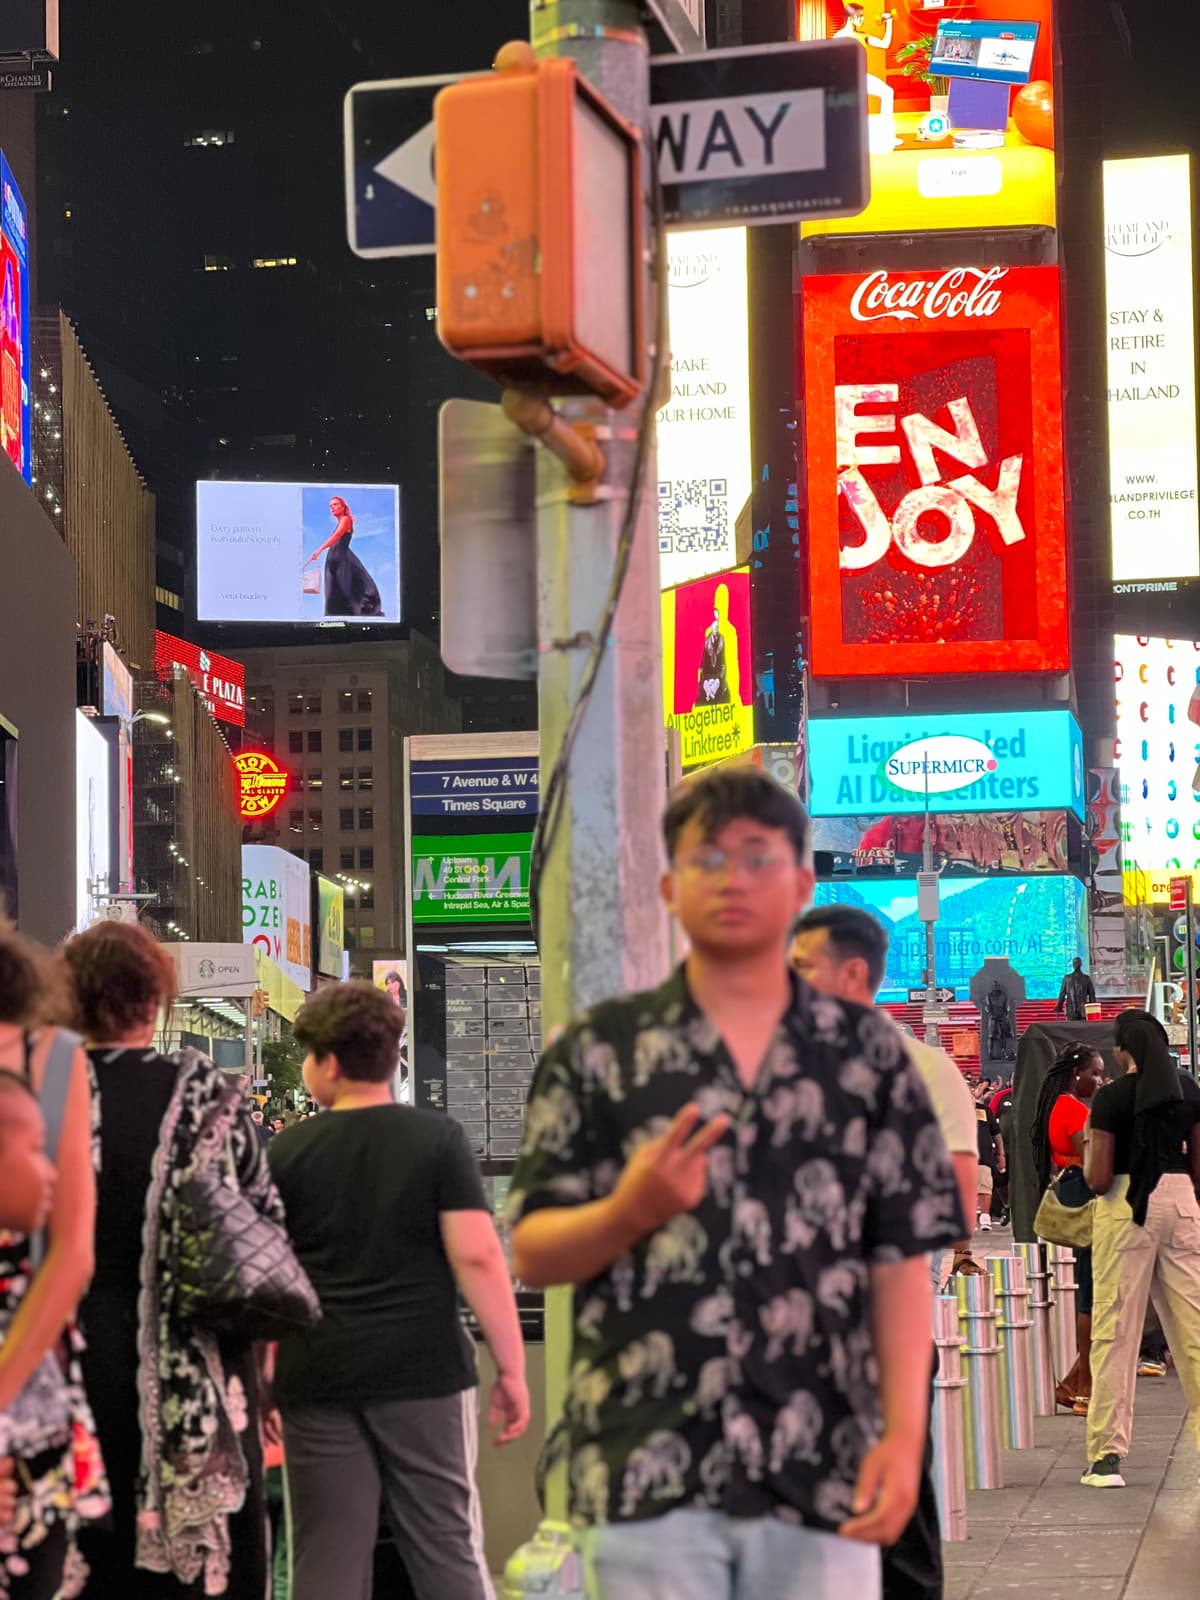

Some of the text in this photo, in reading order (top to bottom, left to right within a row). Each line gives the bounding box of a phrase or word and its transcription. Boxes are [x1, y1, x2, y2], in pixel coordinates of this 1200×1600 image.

[656, 103, 791, 173] WAY
[850, 266, 1009, 321] Coca-Cola
[1110, 308, 1163, 325] STAY &
[1111, 334, 1165, 351] RETIRE
[1131, 360, 1146, 375] IN
[672, 382, 727, 397] AILAND
[1106, 384, 1180, 402] HAILAND
[690, 406, 736, 421] HOME
[1112, 582, 1178, 594] ONTPRIME
[212, 677, 243, 705] PLAZA
[684, 703, 736, 734] together
[236, 757, 267, 771] HOT
[442, 776, 450, 788] 7
[452, 775, 499, 788] Avenue
[501, 774, 512, 786] &
[514, 774, 527, 786] W
[836, 774, 862, 805] AI
[442, 798, 527, 812] Times Square
[443, 857, 472, 866] Uptown
[454, 865, 463, 874] St
[443, 874, 490, 883] Central Park
[242, 879, 278, 900] RAB
[443, 888, 530, 900] Hudson River Greenwa
[443, 901, 473, 911] Intrepid
[474, 901, 490, 910] Sea,
[492, 900, 503, 908] Air
[504, 900, 510, 908] &
